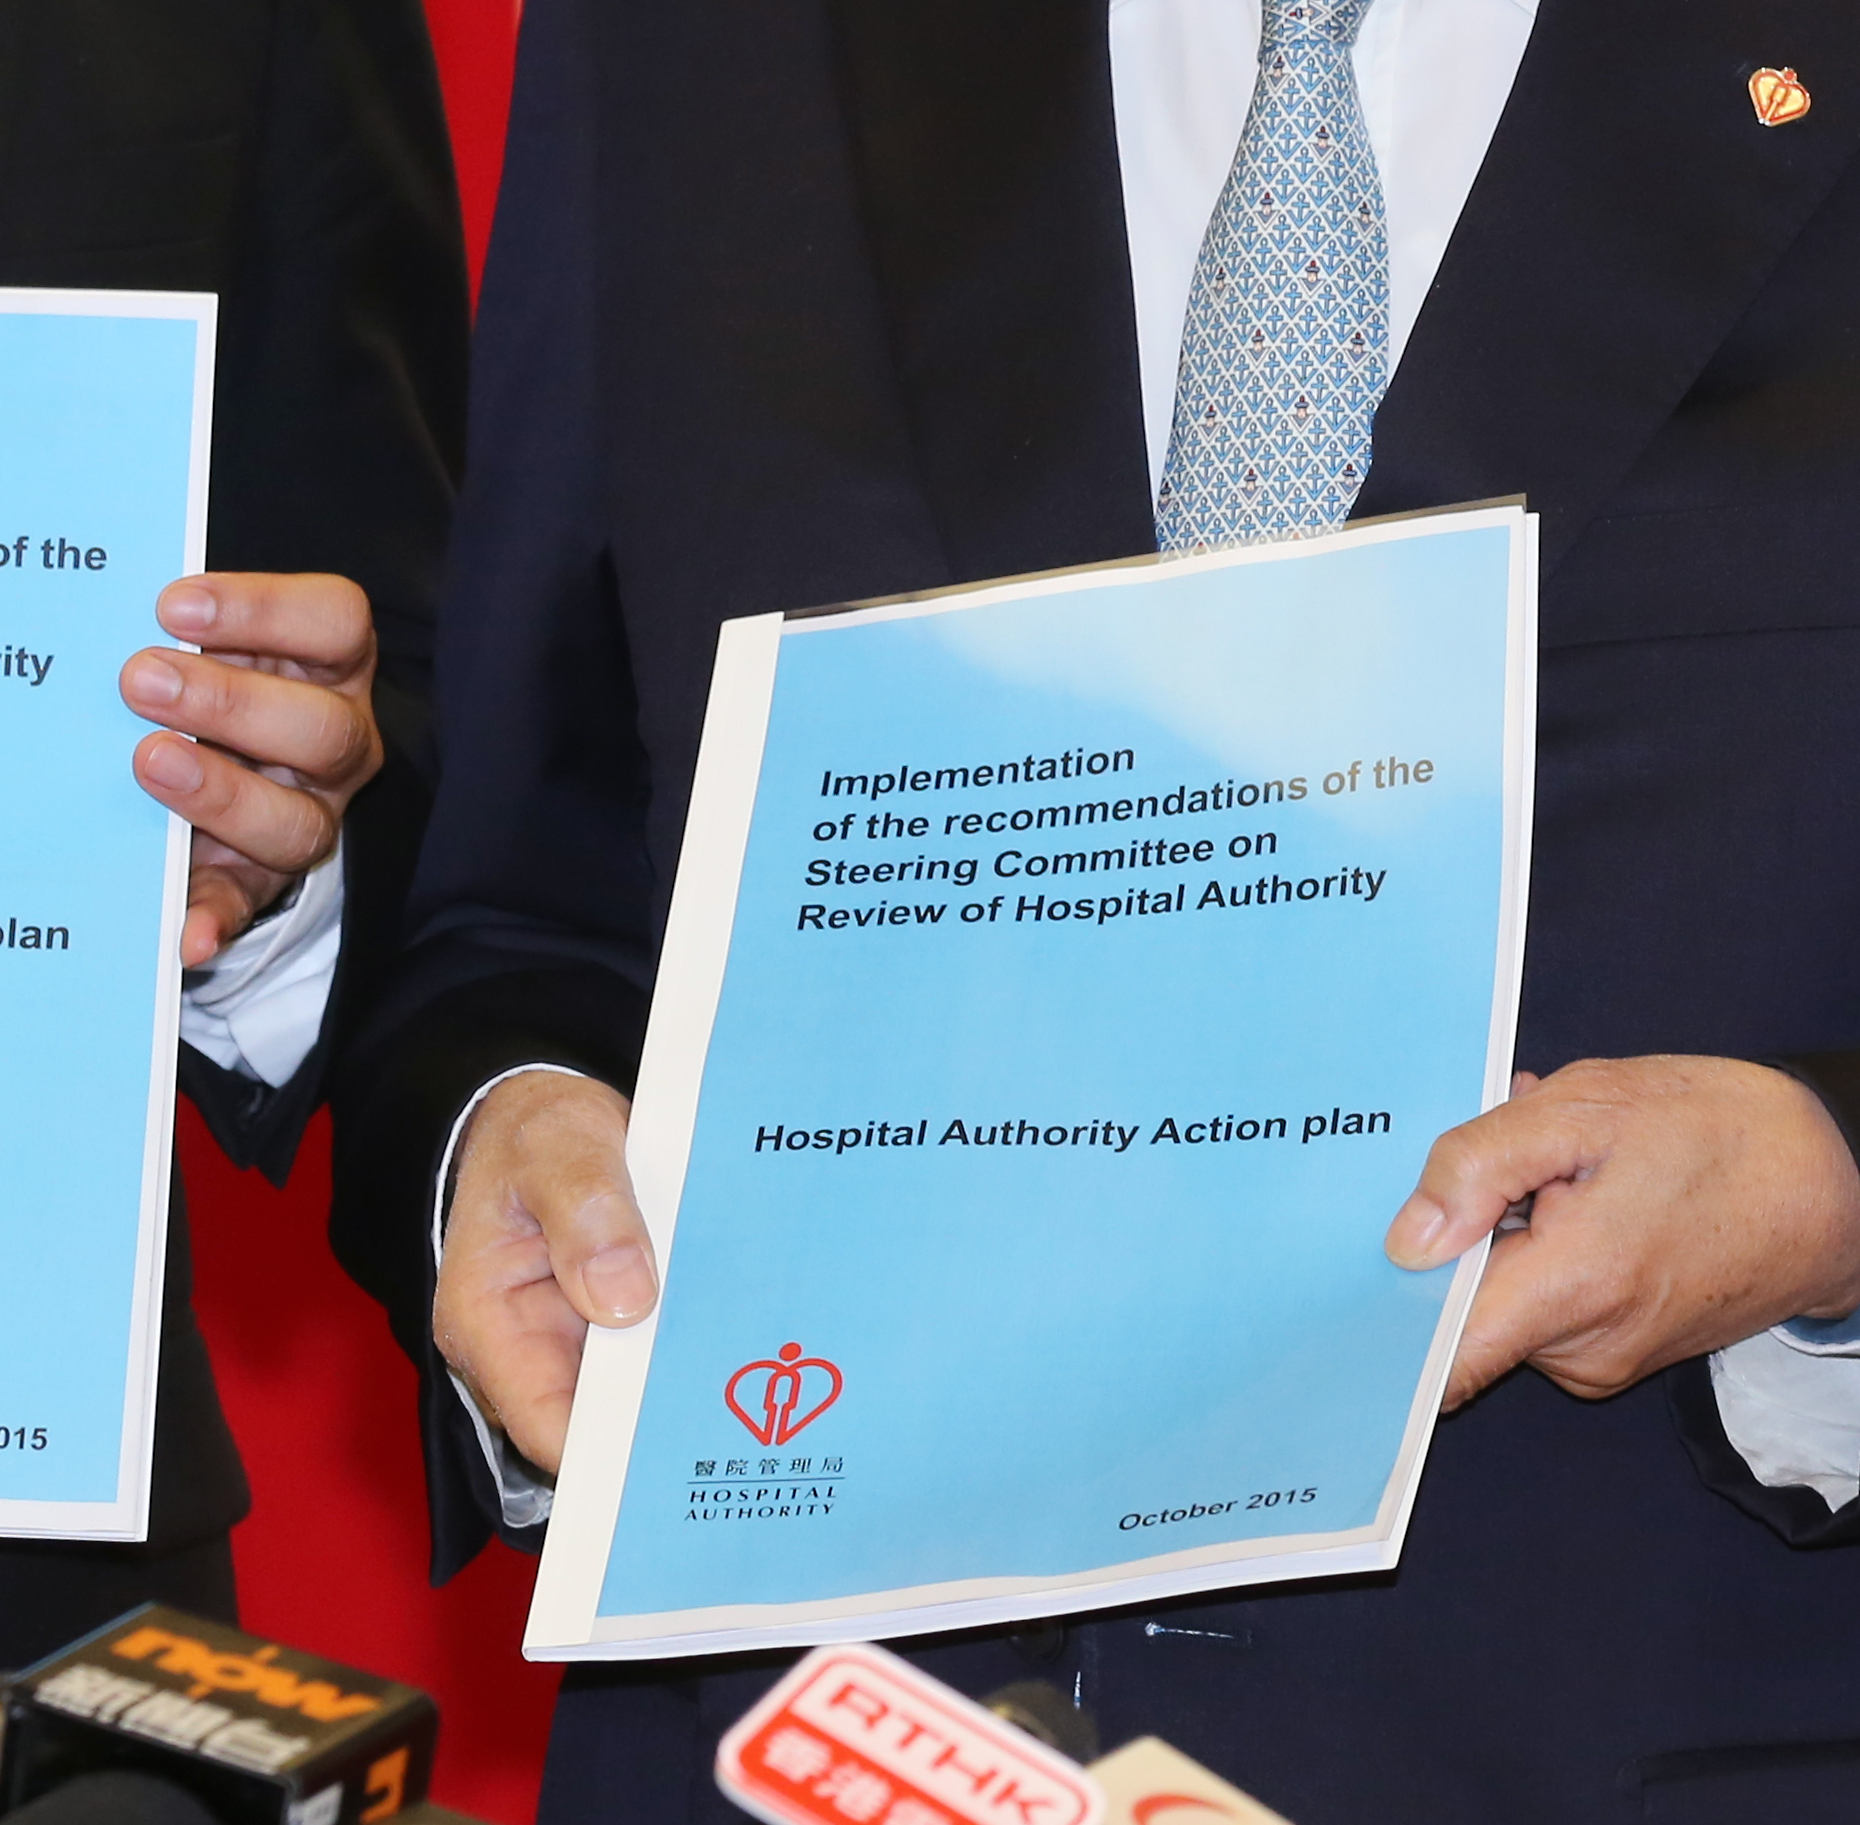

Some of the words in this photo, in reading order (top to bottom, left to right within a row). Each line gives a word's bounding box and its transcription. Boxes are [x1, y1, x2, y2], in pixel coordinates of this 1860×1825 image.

[41, 538, 107, 570] the
[821, 748, 1134, 801] Implementation
[813, 814, 856, 841] of
[867, 812, 929, 839] the
[943, 771, 1307, 835] recommendations
[1323, 761, 1361, 795] of
[1374, 757, 1433, 788] the
[805, 855, 978, 886] Steering
[994, 838, 1214, 878] Committee
[1229, 833, 1276, 858] on
[798, 900, 947, 930] Review
[960, 896, 1005, 923] of
[1015, 884, 1185, 925] Hospital
[1196, 867, 1386, 910] Authority
[755, 1120, 927, 1155] Hospital
[938, 1119, 1140, 1153] Authority
[1150, 1114, 1286, 1144] Action
[1302, 1107, 1390, 1144] plan
[695, 1456, 844, 1478] 醫院管理局
[684, 1502, 836, 1522] AUTHORITY
[689, 1485, 838, 1504] HOSPITAL
[1119, 1501, 1238, 1530] October
[1246, 1488, 1317, 1509] 2015
[830, 1682, 1050, 1825] RTHK
